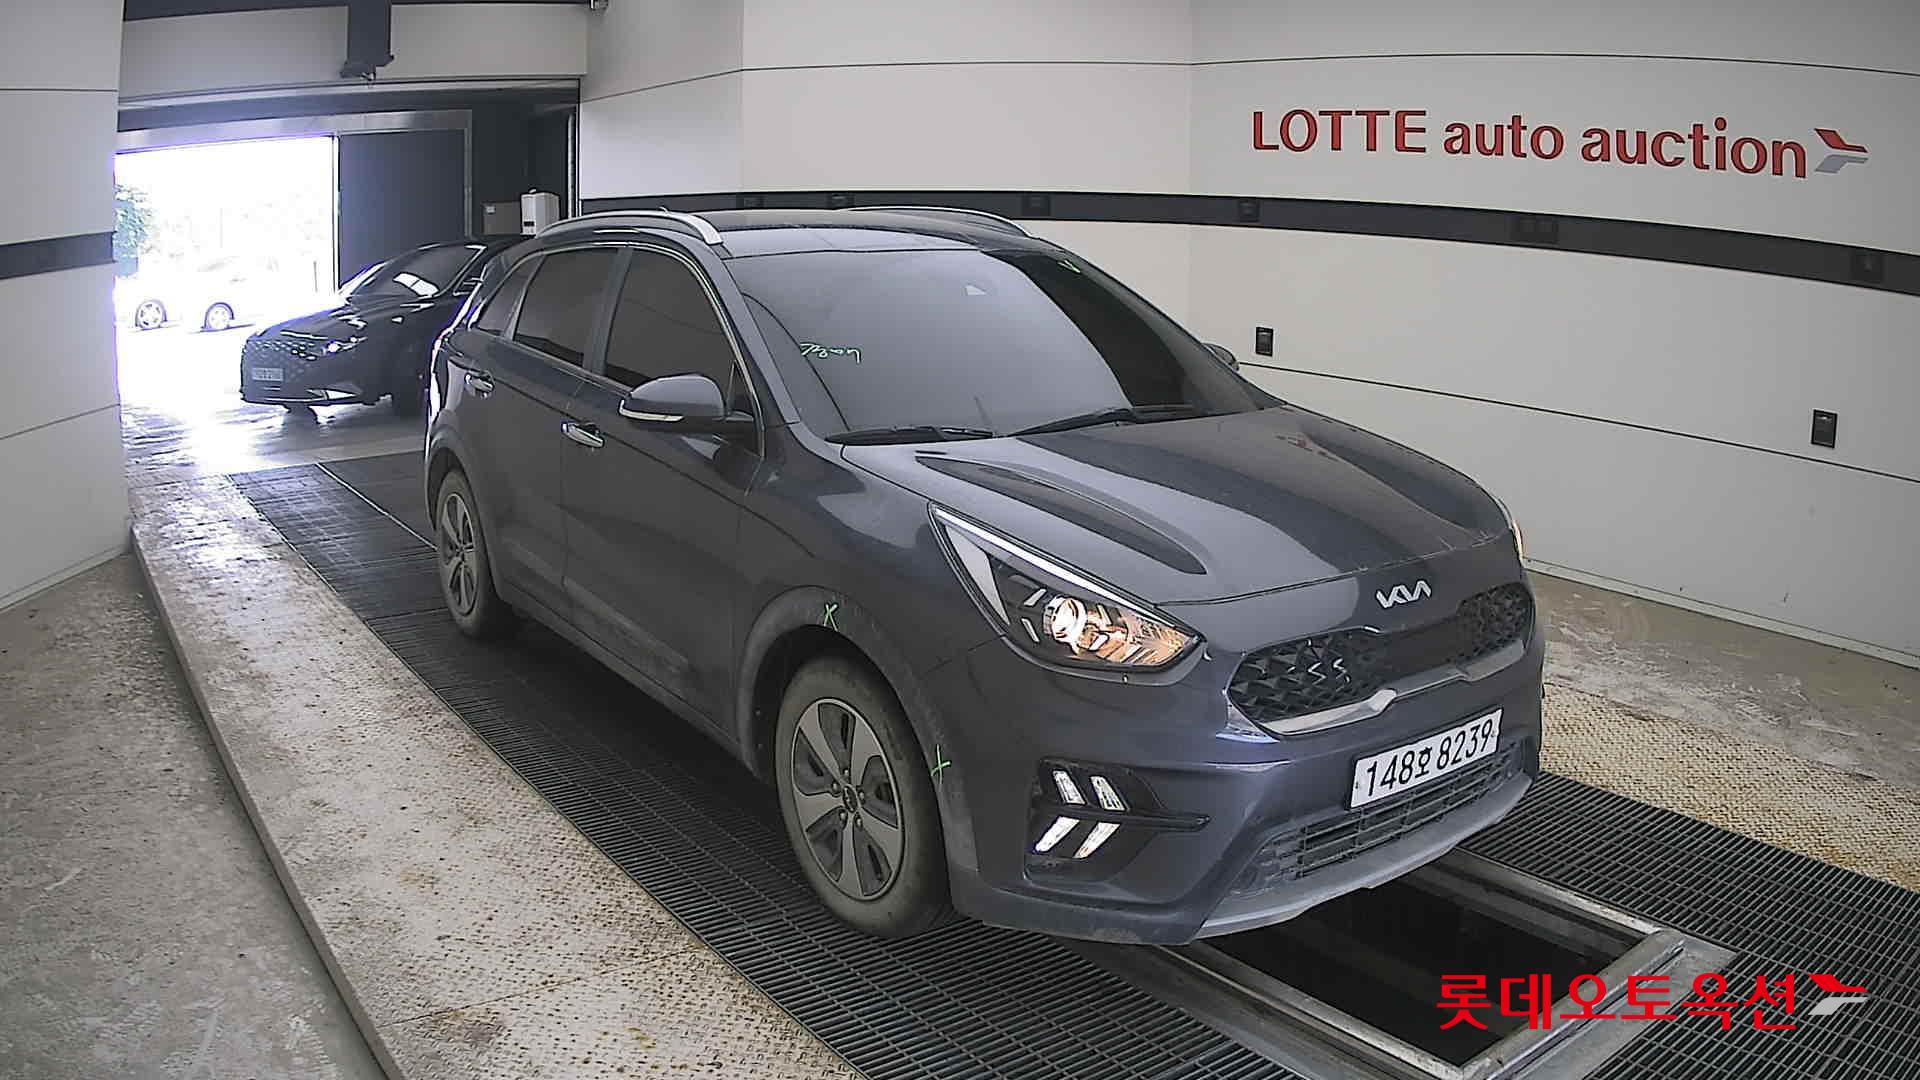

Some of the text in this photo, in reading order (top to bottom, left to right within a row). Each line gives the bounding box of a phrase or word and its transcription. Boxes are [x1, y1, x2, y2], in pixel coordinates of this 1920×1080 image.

[1252, 109, 1808, 179] LOTTE auto auction
[1375, 580, 1432, 609] KIA
[1436, 718, 1494, 771] 8239
